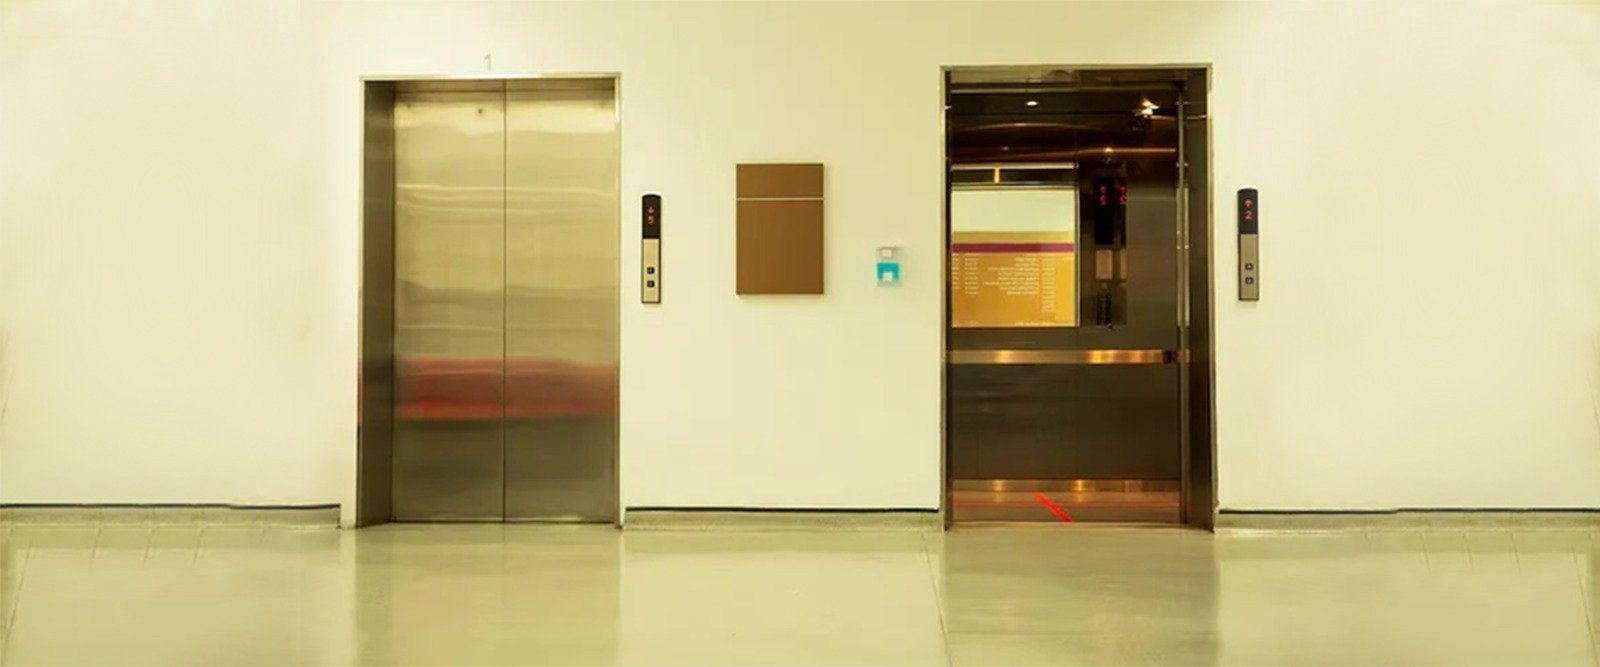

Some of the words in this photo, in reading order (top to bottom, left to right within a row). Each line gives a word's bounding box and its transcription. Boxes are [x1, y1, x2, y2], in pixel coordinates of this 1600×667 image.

[484, 53, 492, 72] 1
[647, 214, 655, 225] 5
[1244, 210, 1253, 220] 2
